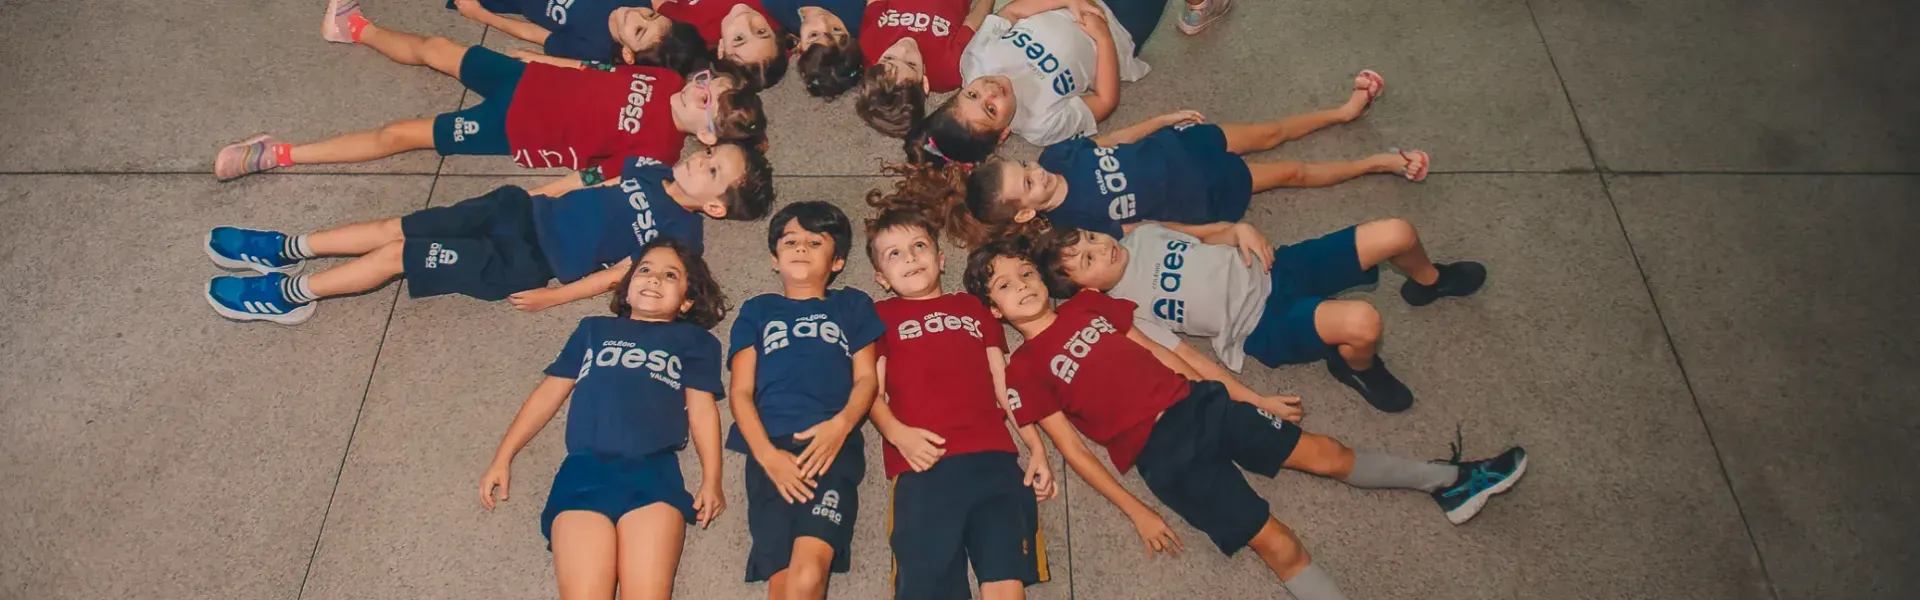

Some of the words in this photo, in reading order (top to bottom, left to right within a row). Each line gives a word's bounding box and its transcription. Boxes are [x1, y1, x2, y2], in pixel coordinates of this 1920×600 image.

[623, 80, 648, 134] aesc
[1094, 146, 1127, 192] aes
[428, 242, 439, 268] aesc
[1160, 240, 1189, 293] aes
[602, 340, 636, 348] COLÉGIO
[596, 346, 682, 380] aesc
[650, 371, 682, 390] VALINHOS
[812, 506, 842, 522] aesc
